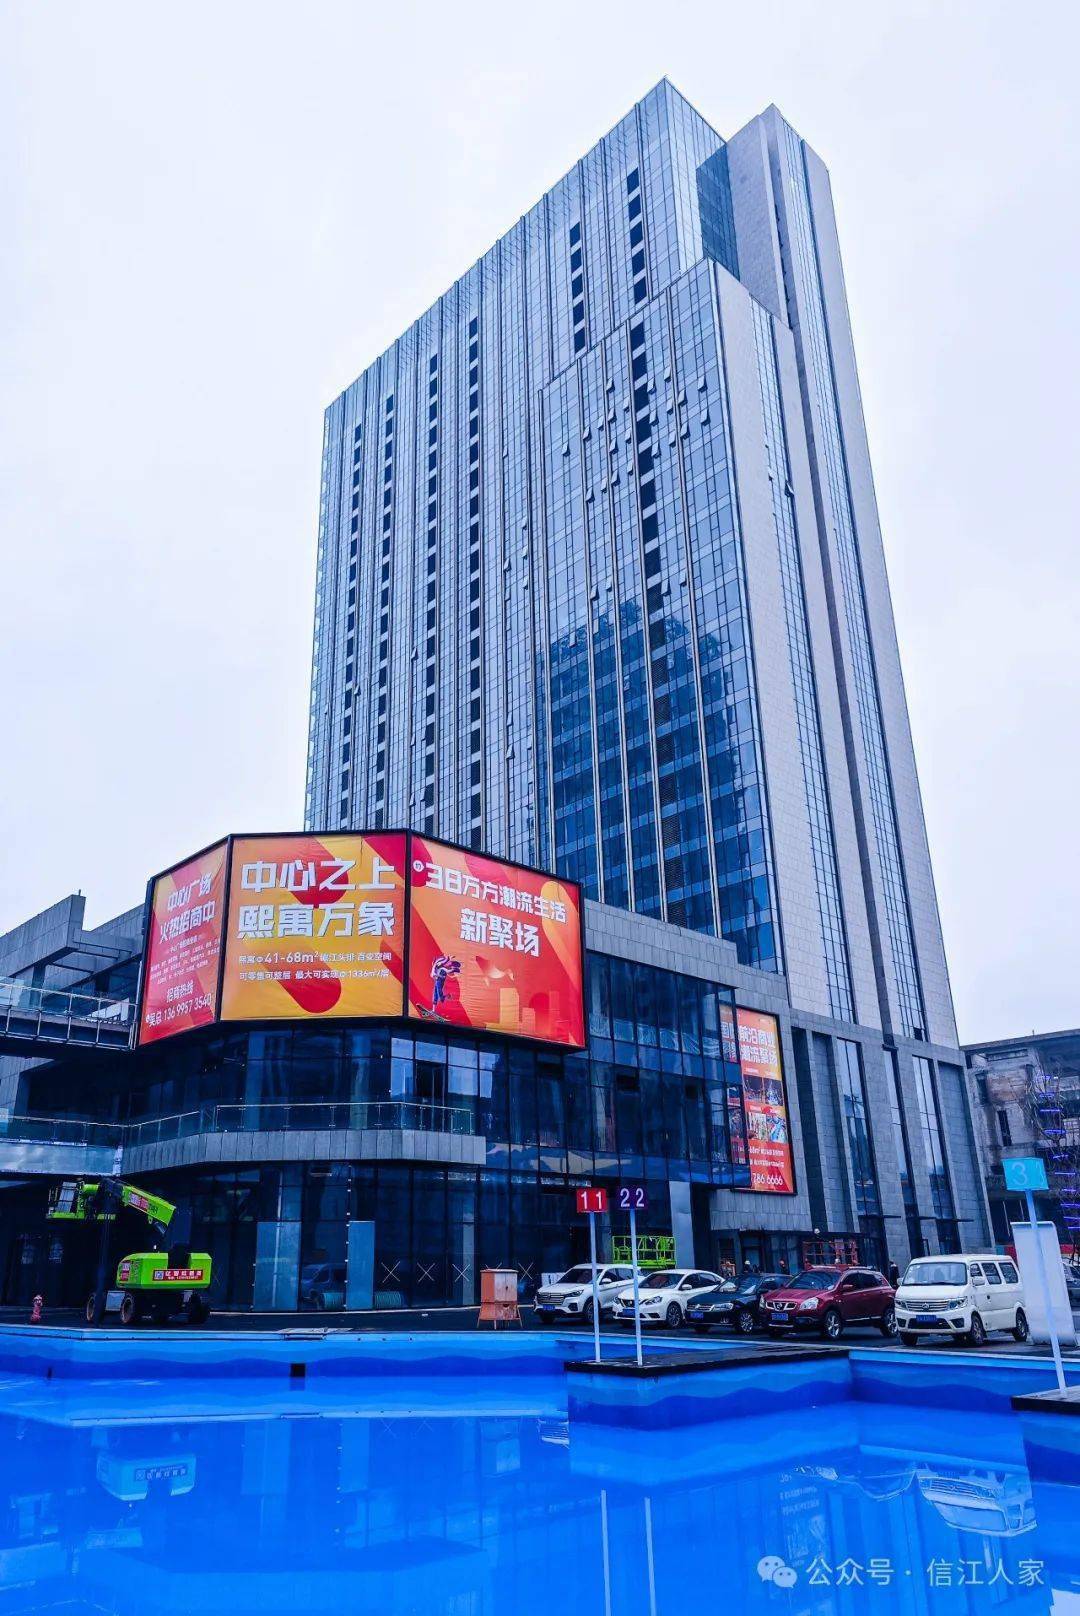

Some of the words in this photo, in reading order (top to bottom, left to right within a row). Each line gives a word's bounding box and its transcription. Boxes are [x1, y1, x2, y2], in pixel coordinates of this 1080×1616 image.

[167, 872, 212, 913] 中心广场
[240, 857, 395, 893] 中心之上
[159, 900, 215, 944] 火热招商中
[460, 907, 540, 957] 新聚场
[163, 1007, 175, 1021] 136
[1012, 1162, 1028, 1186] 3
